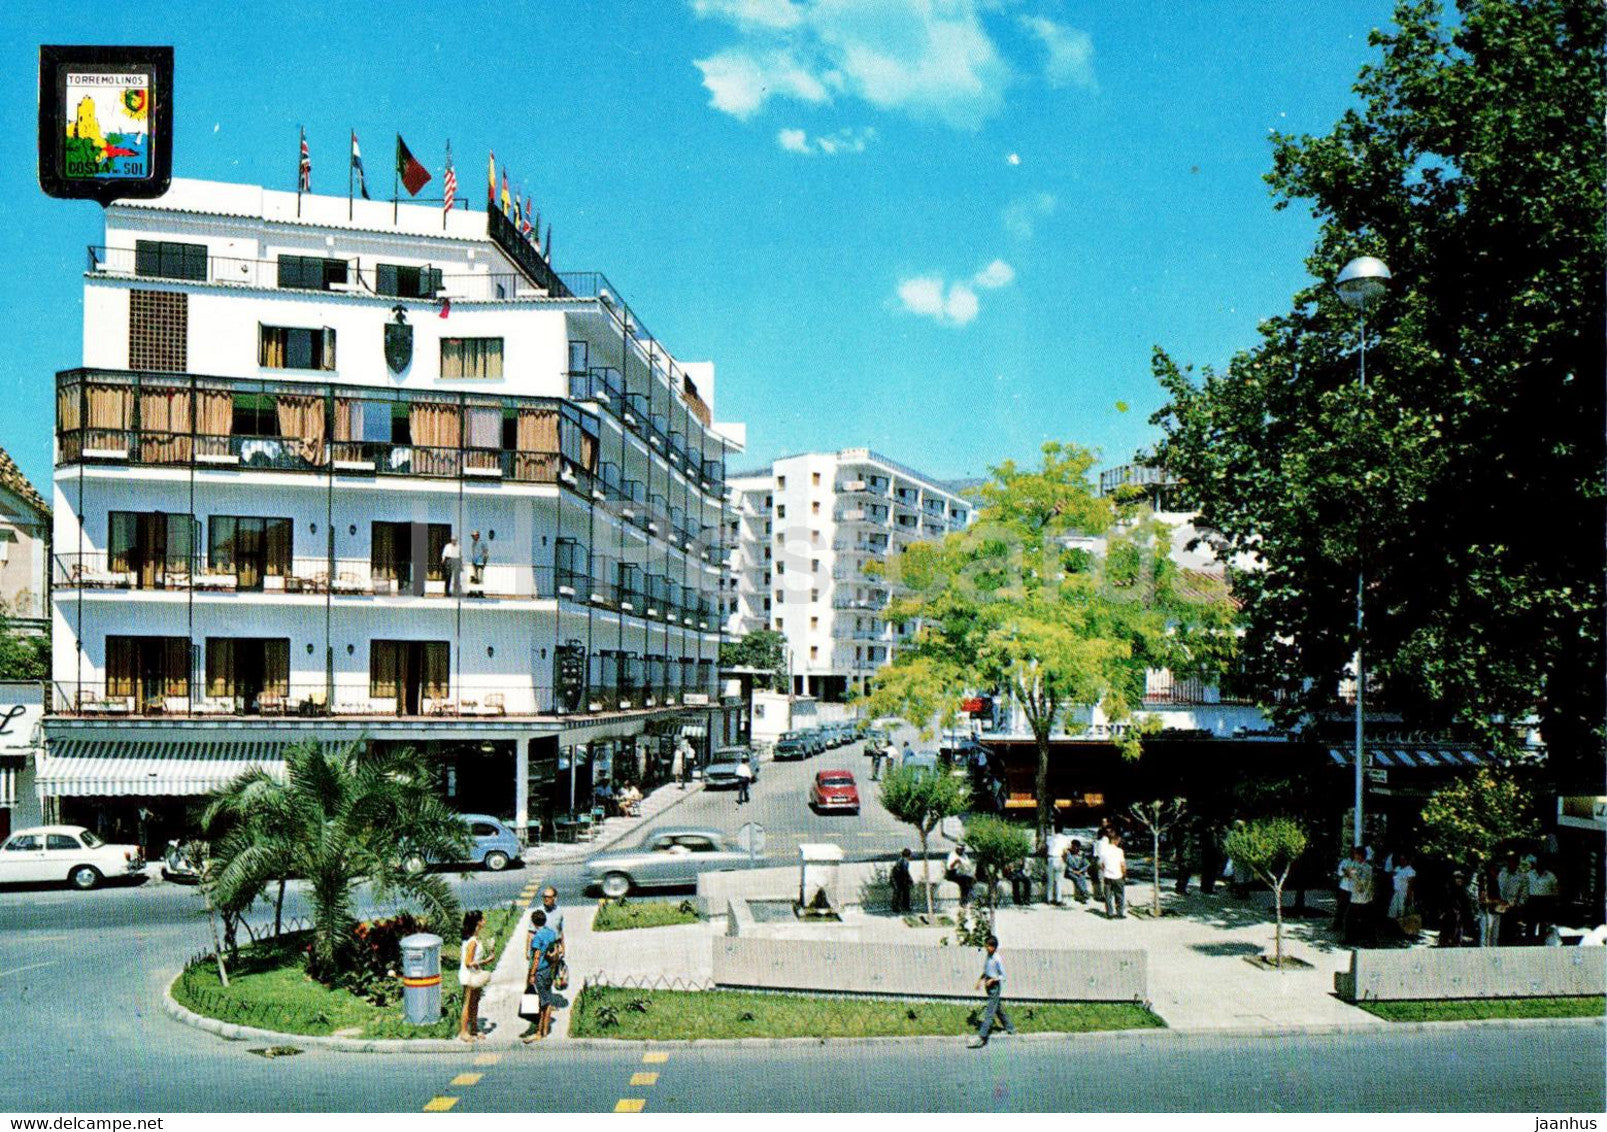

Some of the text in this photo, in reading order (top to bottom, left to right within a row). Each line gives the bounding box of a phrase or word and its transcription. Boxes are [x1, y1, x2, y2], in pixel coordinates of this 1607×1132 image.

[69, 75, 143, 85] TORREMOLINOS
[68, 161, 110, 174] COSTA
[124, 162, 144, 175] SOL
